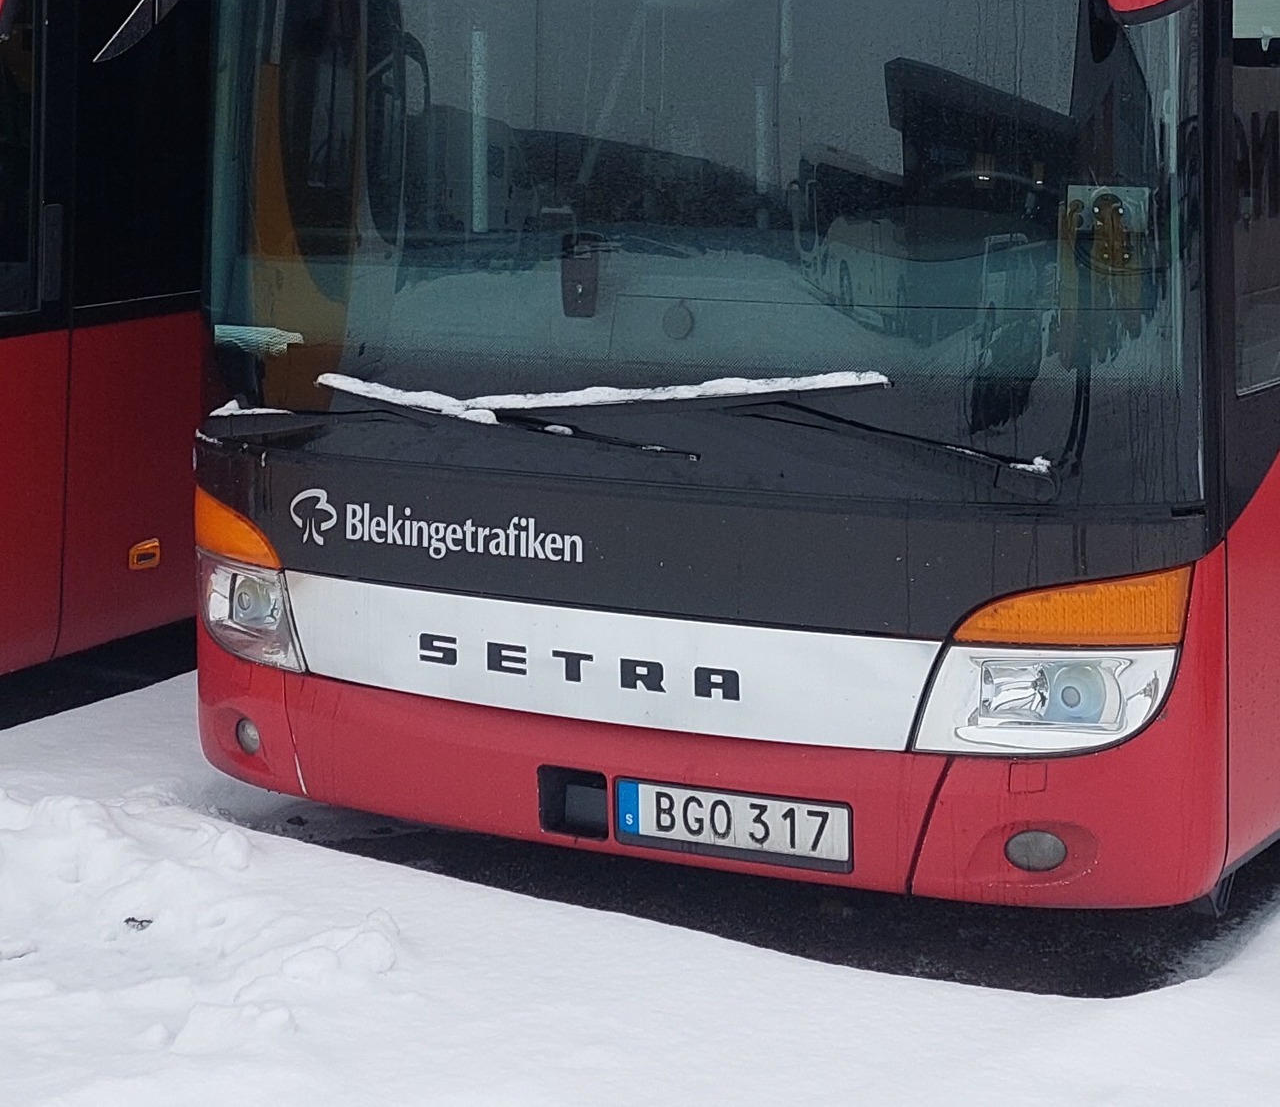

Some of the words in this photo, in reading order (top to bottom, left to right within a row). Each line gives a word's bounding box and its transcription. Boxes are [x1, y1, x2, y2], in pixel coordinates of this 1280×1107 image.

[345, 502, 584, 563] Blekingetrafiken
[419, 632, 741, 701] SETRA
[624, 814, 634, 826] S
[655, 791, 733, 840] BGO
[748, 802, 830, 853] 317
